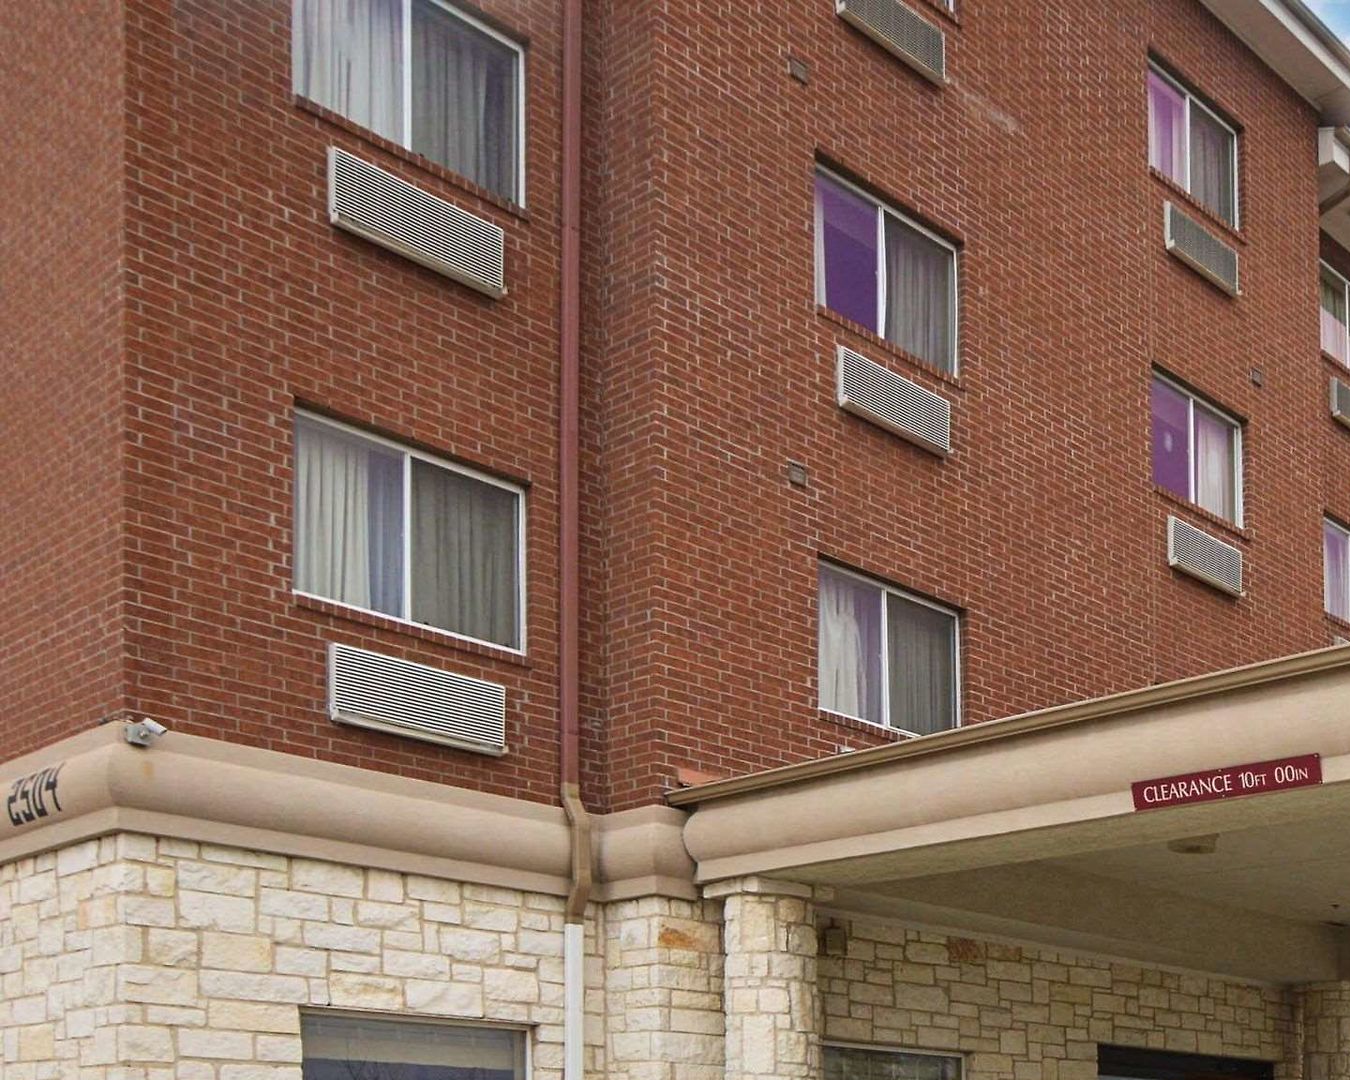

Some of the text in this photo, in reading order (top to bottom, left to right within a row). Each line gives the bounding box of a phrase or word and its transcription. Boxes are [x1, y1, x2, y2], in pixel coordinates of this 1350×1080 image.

[7, 761, 66, 827] 2504
[1143, 765, 1309, 803] CLEARANCE 10FT 00IN
